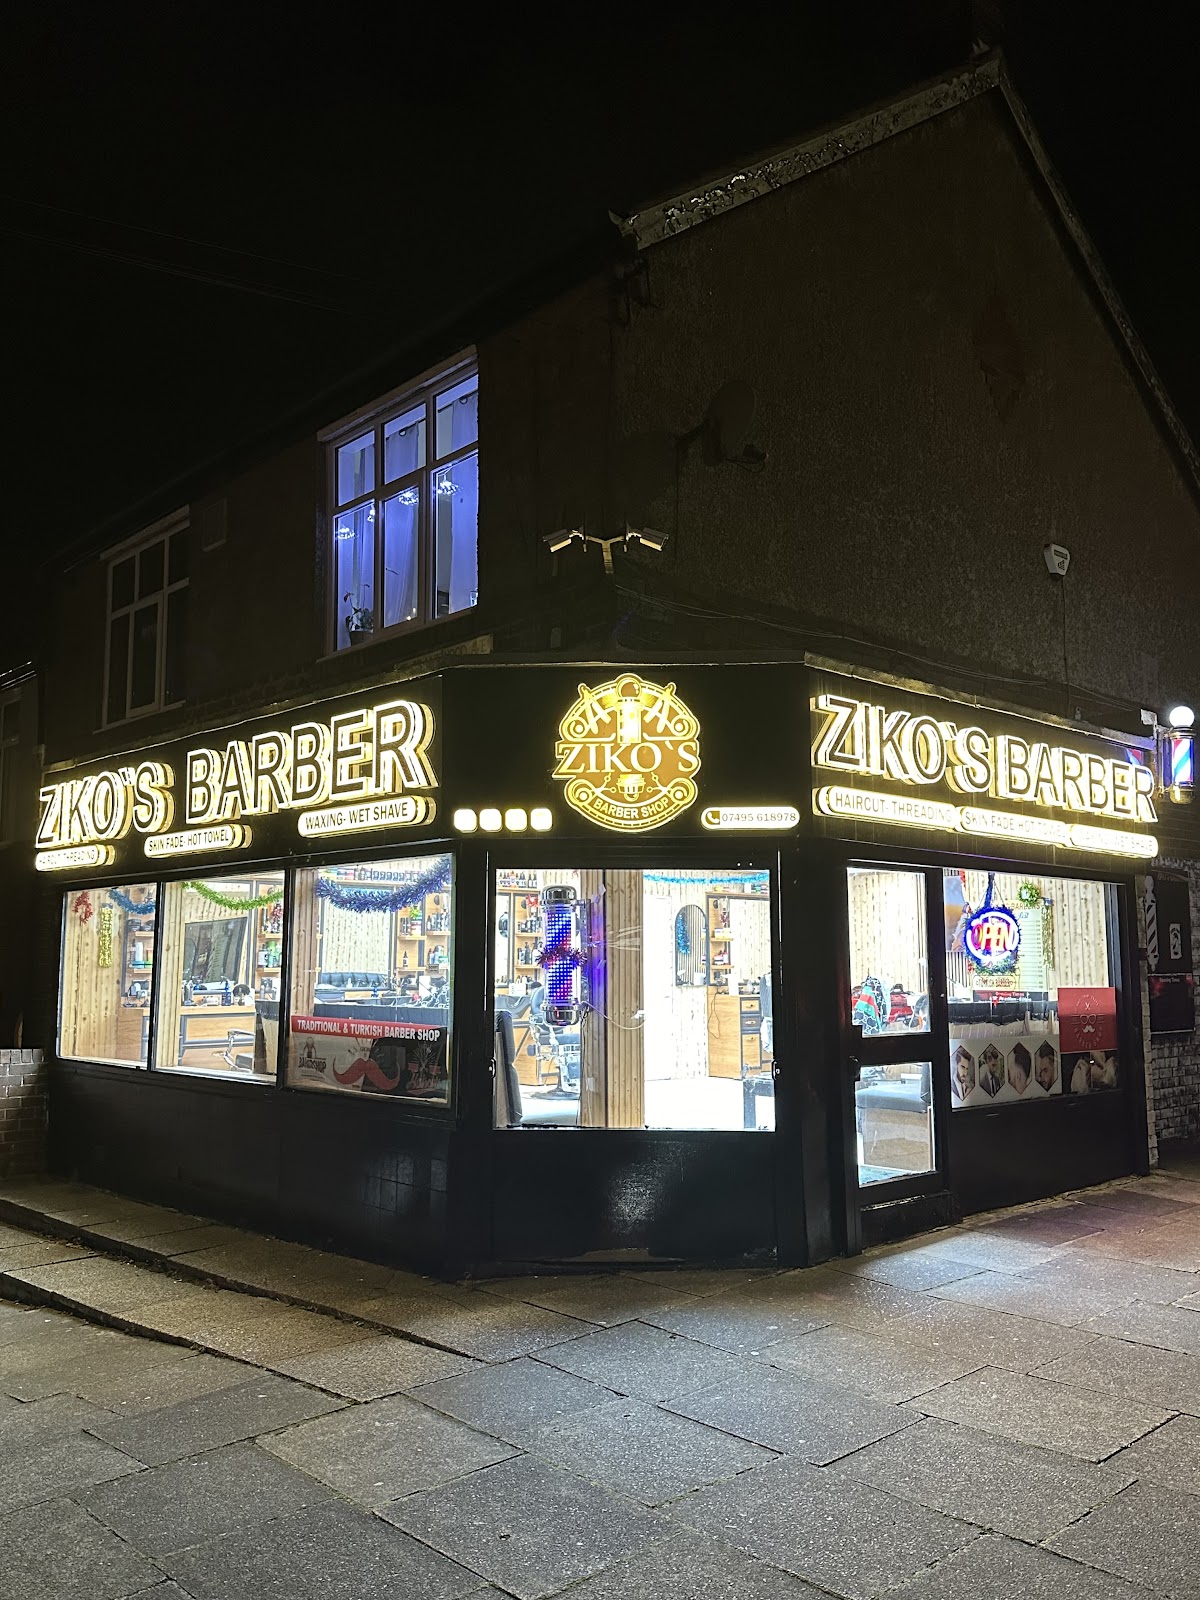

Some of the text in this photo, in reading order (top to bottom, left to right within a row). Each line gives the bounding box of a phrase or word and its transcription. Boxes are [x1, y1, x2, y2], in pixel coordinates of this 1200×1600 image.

[810, 694, 1158, 822] ZIKO'S BARBER
[36, 700, 438, 849] ZIKO'S BARBER
[349, 808, 371, 824] WET
[373, 802, 408, 820] SHAVE
[592, 798, 671, 819] BARBER SHOP
[722, 812, 796, 822] 07495 618978
[892, 801, 951, 823] THREADING
[965, 811, 988, 827] SKIN
[1018, 820, 1035, 833] HOT
[149, 840, 164, 852] SKIN
[188, 833, 201, 846] HOT
[204, 829, 229, 844] TOWEL
[971, 919, 1016, 951] OPEN
[297, 1019, 441, 1042] TRADITIONAL & TURKISH BARBER SHOP
